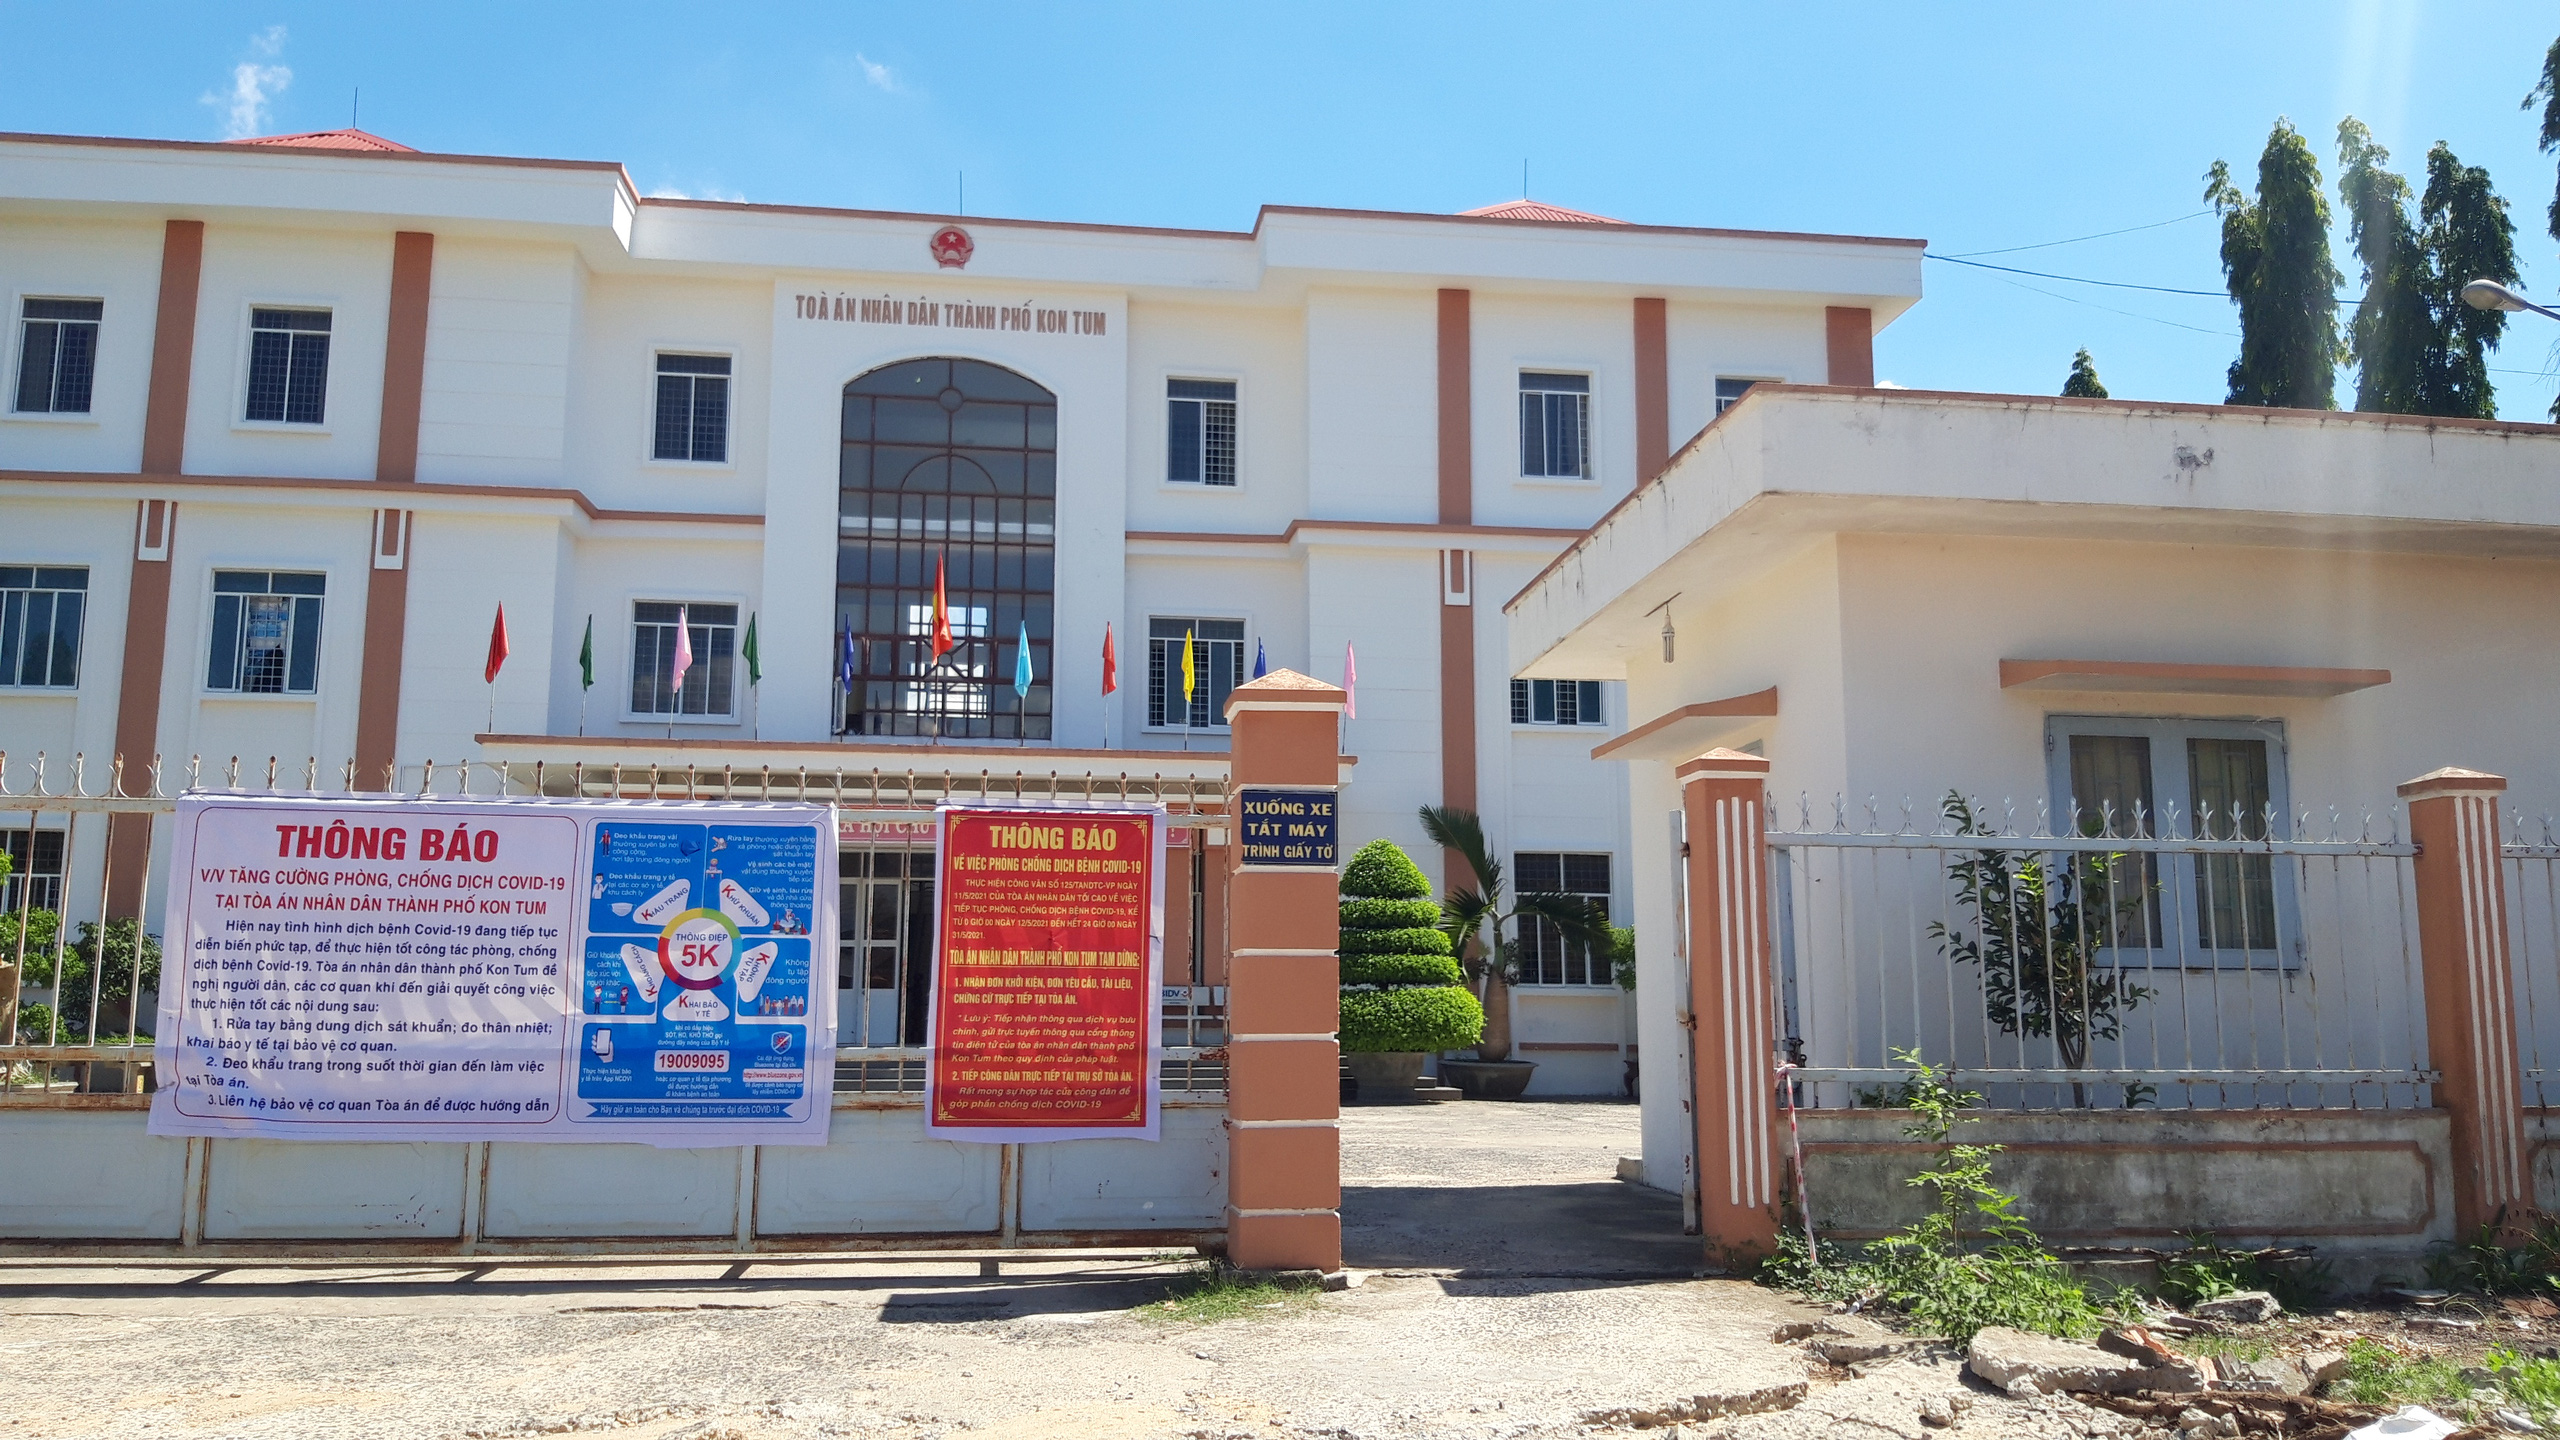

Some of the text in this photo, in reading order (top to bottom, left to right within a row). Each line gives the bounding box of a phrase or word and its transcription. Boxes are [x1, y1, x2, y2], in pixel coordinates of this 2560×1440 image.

[796, 291, 1106, 336] TOÀ ÁN NHÂN DÂN THÀNH PHỐ KON TUM
[1244, 798, 1332, 816] XUỐNG XE
[990, 822, 1116, 851] THÔNG BÁO
[1248, 818, 1327, 837] TẮT MÁY
[276, 819, 498, 862] THÔNG BÁO
[1242, 841, 1333, 858] TRÌNH GIẤY TỜ
[954, 853, 1141, 876] VỀ VIỆC PHÒNG CHỐNG DỊCH BỆNH COVID-19
[202, 866, 564, 891] V/V TĂNG CƯỜNG PHÒNG, CHỐNG DỊCH COVID-19
[216, 891, 546, 914] TẠI TÒA ÁN NHÂN DÂN THÀNH PHỐ KON TUM
[226, 920, 558, 939] Hiện nay tình hình dịch bệnh Covid-19 đang tiếp tục
[676, 932, 728, 942] THÔNG ĐIỆP
[952, 931, 985, 939] 31/5/2021.
[681, 944, 719, 966] 5K
[950, 945, 1140, 968] TÒA ÁN NHÂN DÂN THÀNH PHỐ KON TUM TẠM DỪNG:
[194, 959, 557, 977] dịch bệnh Covid-19. Tòa án nhân dân thành phố Kon Tum đề
[191, 998, 378, 1014] thực hiện tốt các nội dung sau:
[213, 1017, 552, 1035] 1. Rửa tay bằng dung dịch sát khuẩn; đo thân nhiệt;
[660, 1054, 724, 1068] 19009095
[186, 1074, 248, 1088] tại Tòa án.
[950, 1099, 1101, 1110] góp phần chống dịch COVID-19
